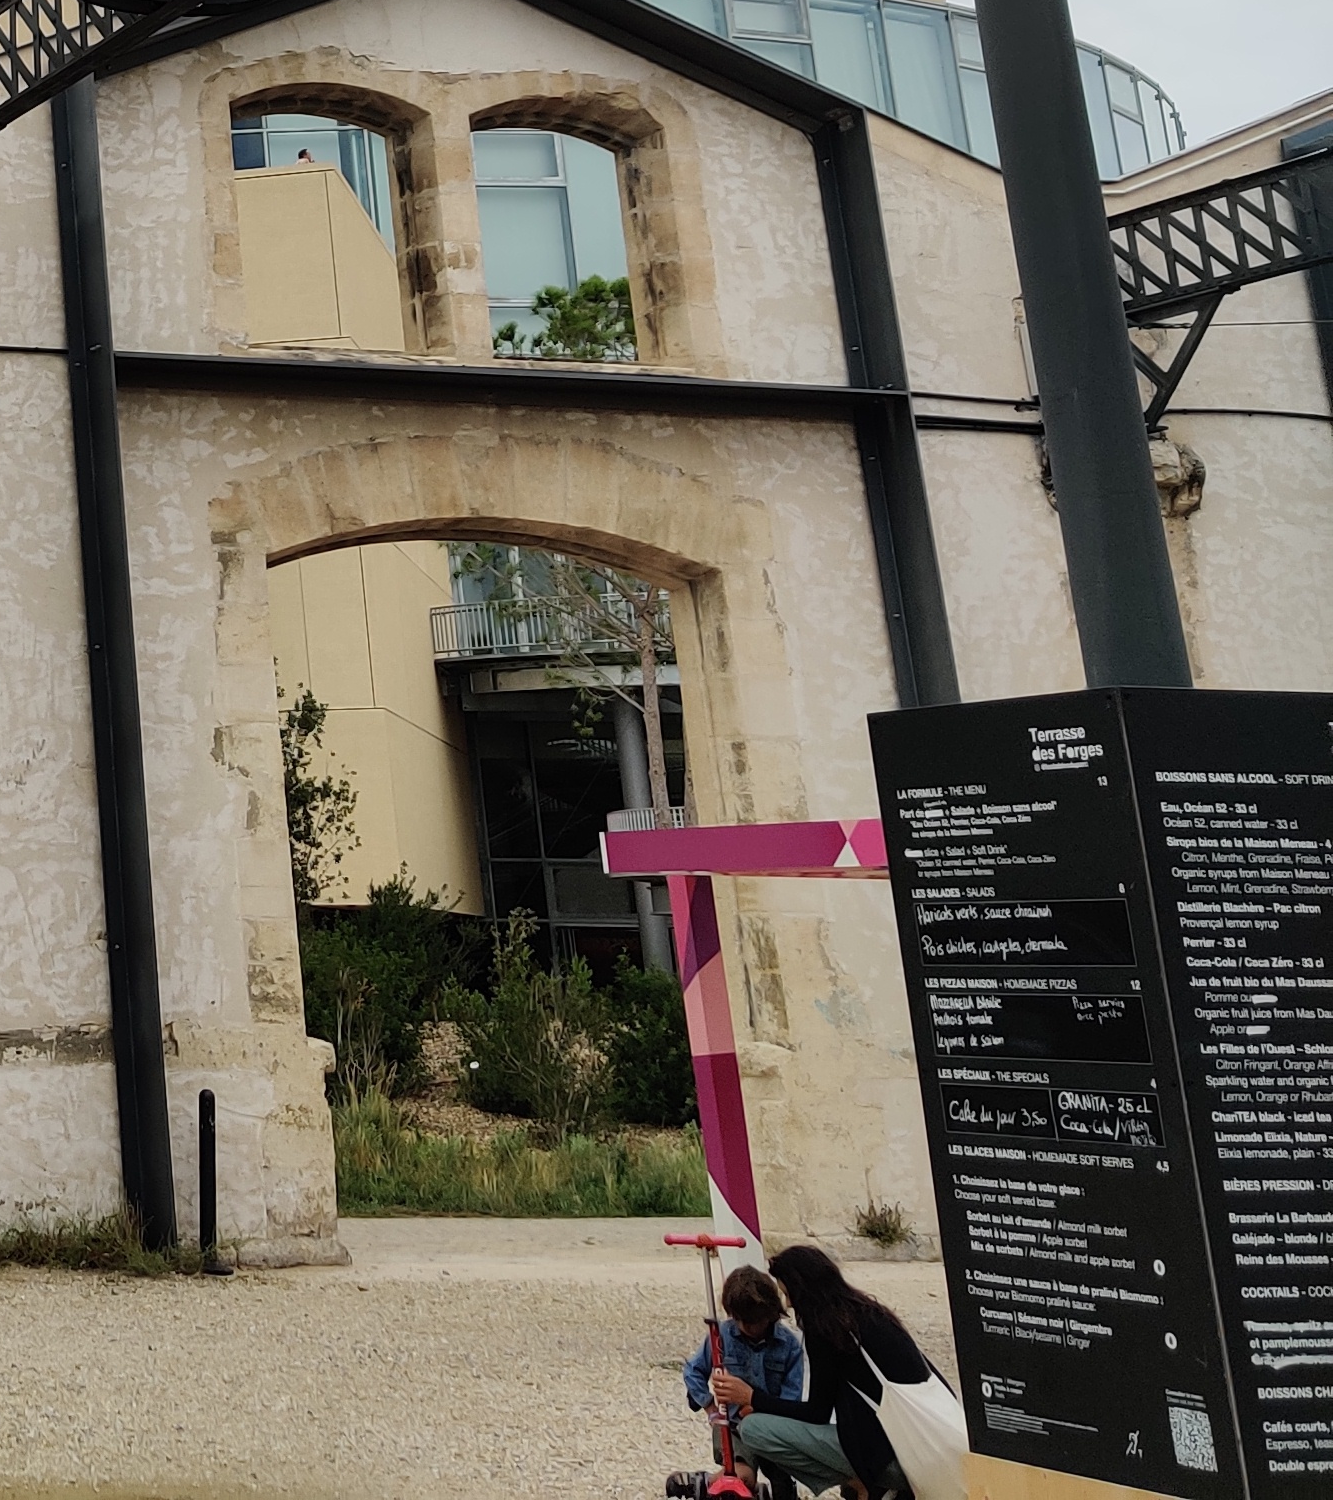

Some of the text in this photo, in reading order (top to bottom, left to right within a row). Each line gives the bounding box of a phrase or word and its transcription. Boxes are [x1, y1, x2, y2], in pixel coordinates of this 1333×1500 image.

[1028, 727, 1085, 743] Terrasse
[1032, 743, 1103, 761] des Forges
[1097, 776, 1108, 786] 13
[1155, 772, 1309, 784] BOISSONS SANS ALCOOL SOFT
[897, 785, 986, 800] LA FORMULE THE MENU
[1161, 802, 1257, 813] Eau, Océan 52 33 cl
[1163, 817, 1298, 829] Océan 52, canned water 33 cl
[1166, 836, 1197, 848] Sirops
[1198, 837, 1219, 847] bios
[1220, 839, 1232, 847] de
[1234, 838, 1243, 848] la
[1244, 838, 1279, 848] Maison
[1182, 852, 1322, 864] Citron, Menthe, Grenadine, Fraise,
[1172, 867, 1206, 879] Organic
[1208, 870, 1237, 880] syrups
[1239, 868, 1259, 878] from
[1261, 868, 1293, 878] Maison
[911, 887, 995, 898] LES SALADES SALADS
[1187, 883, 1289, 894] Lemon, Mint, Grenadine,
[1177, 902, 1321, 913] Distillerie Blachère Pac citron
[1180, 917, 1279, 930] Provençal lemon syrup
[1183, 937, 1246, 947] Perrier 33 cl
[1186, 956, 1324, 968] Coca-Cola Coca Zéro 33 cl
[924, 978, 1077, 990] LES PIZZAS MAISON HOMEMADE PIZZAS
[1130, 980, 1141, 990] 12
[1190, 976, 1296, 987] Jus de fruit bio du Mas
[1205, 992, 1238, 1002] Pomme
[1195, 1008, 1316, 1020] Organic fruit juice from Mas
[1210, 1024, 1235, 1036] Apple
[1200, 1043, 1295, 1054] Les Filles de l'Ouest
[1216, 1059, 1242, 1069] Citron
[1283, 1059, 1315, 1072] Orange
[937, 1068, 953, 1079] LES
[995, 1071, 1013, 1082] THE
[1012, 1072, 1050, 1084] SPECIALS
[1206, 1075, 1329, 1088] Sparkling water and organic
[1222, 1091, 1253, 1102] Lemon,
[1256, 1091, 1288, 1104] Orange
[1258, 1111, 1286, 1122] black
[1316, 1112, 1332, 1122] tea
[1215, 1132, 1262, 1142] Limonade
[1295, 1132, 1327, 1142] Nature
[948, 1144, 1134, 1169] LES GLACES MAISON HOMEMADE SOFT SERVES
[1244, 1148, 1291, 1159] lemonade,
[1293, 1148, 1315, 1160] plain
[1223, 1178, 1314, 1191] BIÈRES PRESSION
[1229, 1212, 1289, 1223] Brasserie La
[1232, 1232, 1318, 1246] Galéjade blonde
[1236, 1254, 1329, 1265] Reine des Mousses
[1241, 1286, 1299, 1298] COCKTAILS
[1258, 1387, 1313, 1399] BOISSONS
[1263, 1421, 1330, 1433] Cafés courts,
[1266, 1439, 1312, 1452] Espresso,
[1269, 1460, 1305, 1471] Double
